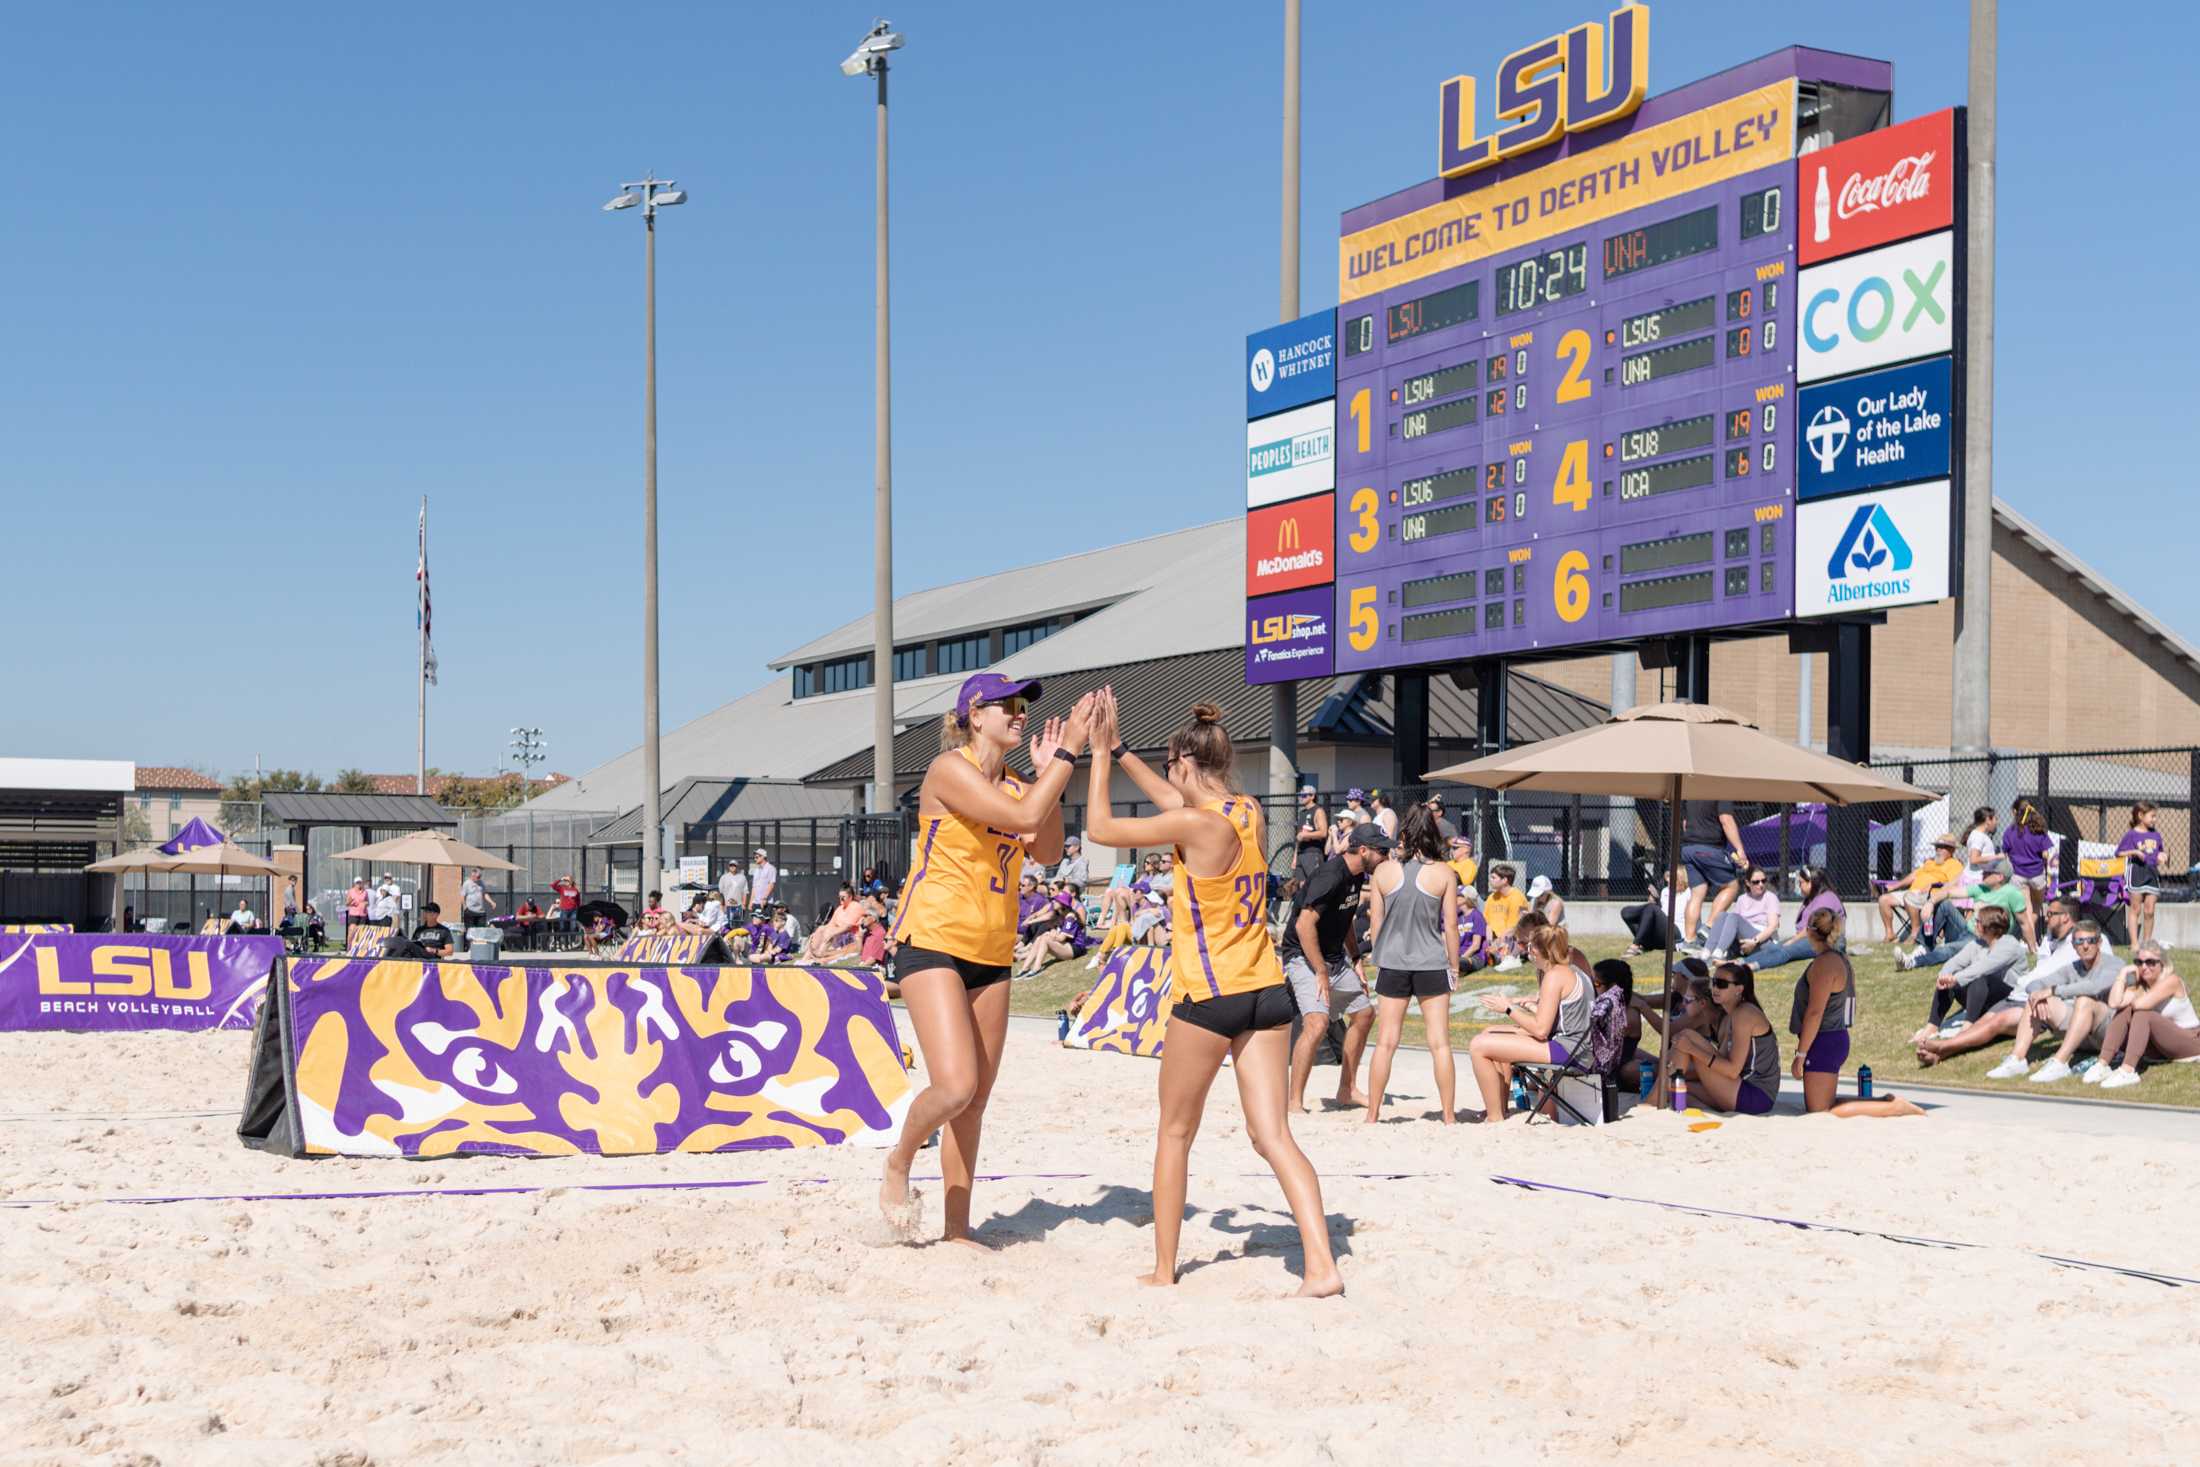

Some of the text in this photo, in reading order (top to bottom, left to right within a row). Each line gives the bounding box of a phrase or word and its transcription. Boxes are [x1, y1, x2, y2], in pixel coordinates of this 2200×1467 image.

[1440, 4, 1649, 178] LSU
[1349, 109, 1779, 280] WELCOME TO DEATH VOLLEY
[1763, 188, 1781, 233] 0
[1604, 231, 1647, 273] UNA
[1508, 245, 1587, 310] 10:24
[1756, 261, 1785, 280] WON
[1770, 284, 1777, 307] 1
[1803, 260, 1946, 353] COX
[1360, 316, 1373, 352] 0
[1388, 301, 1423, 340] LSU
[1623, 315, 1660, 348] LSU5
[1278, 335, 1332, 360] HANCOCK
[1510, 332, 1533, 349] WON
[1764, 321, 1776, 349] 0
[1278, 352, 1332, 380] WHITNEY
[1516, 350, 1527, 375] 0
[1556, 329, 1592, 404] 2
[1623, 355, 1650, 386] UNA
[1405, 377, 1434, 405] LSU4
[1516, 384, 1527, 409] 0
[1755, 384, 1784, 402] WON
[1857, 385, 1927, 416] Our Lady
[1350, 387, 1371, 453] 1
[1404, 416, 1427, 440] UNA
[1733, 410, 1750, 437] 19
[1763, 404, 1776, 433] 0
[1857, 410, 1941, 443] of the Lake
[1251, 434, 1329, 472] PEOPLES HEALTH
[1509, 440, 1532, 457] WON
[1621, 431, 1659, 462] LSU8
[1763, 443, 1776, 471] 0
[1857, 440, 1905, 467] Health
[1486, 463, 1506, 490] 21
[1516, 458, 1526, 484] 0
[1553, 439, 1592, 512] 4
[1621, 469, 1650, 500] UCA
[1403, 481, 1433, 507] LSU6
[1515, 493, 1526, 518] 0
[1348, 487, 1380, 553] 3
[1491, 496, 1505, 522] 15
[1755, 504, 1784, 522] WON
[1402, 518, 1426, 541] UNA
[1256, 549, 1324, 577] McDonald's
[1508, 548, 1532, 564] WON
[1553, 550, 1591, 623] 6
[1827, 578, 1911, 604] Albertsons
[1348, 585, 1379, 652] 5
[35, 946, 213, 1001] LSU
[40, 1001, 216, 1016] BEACH VOLLEYBALL
